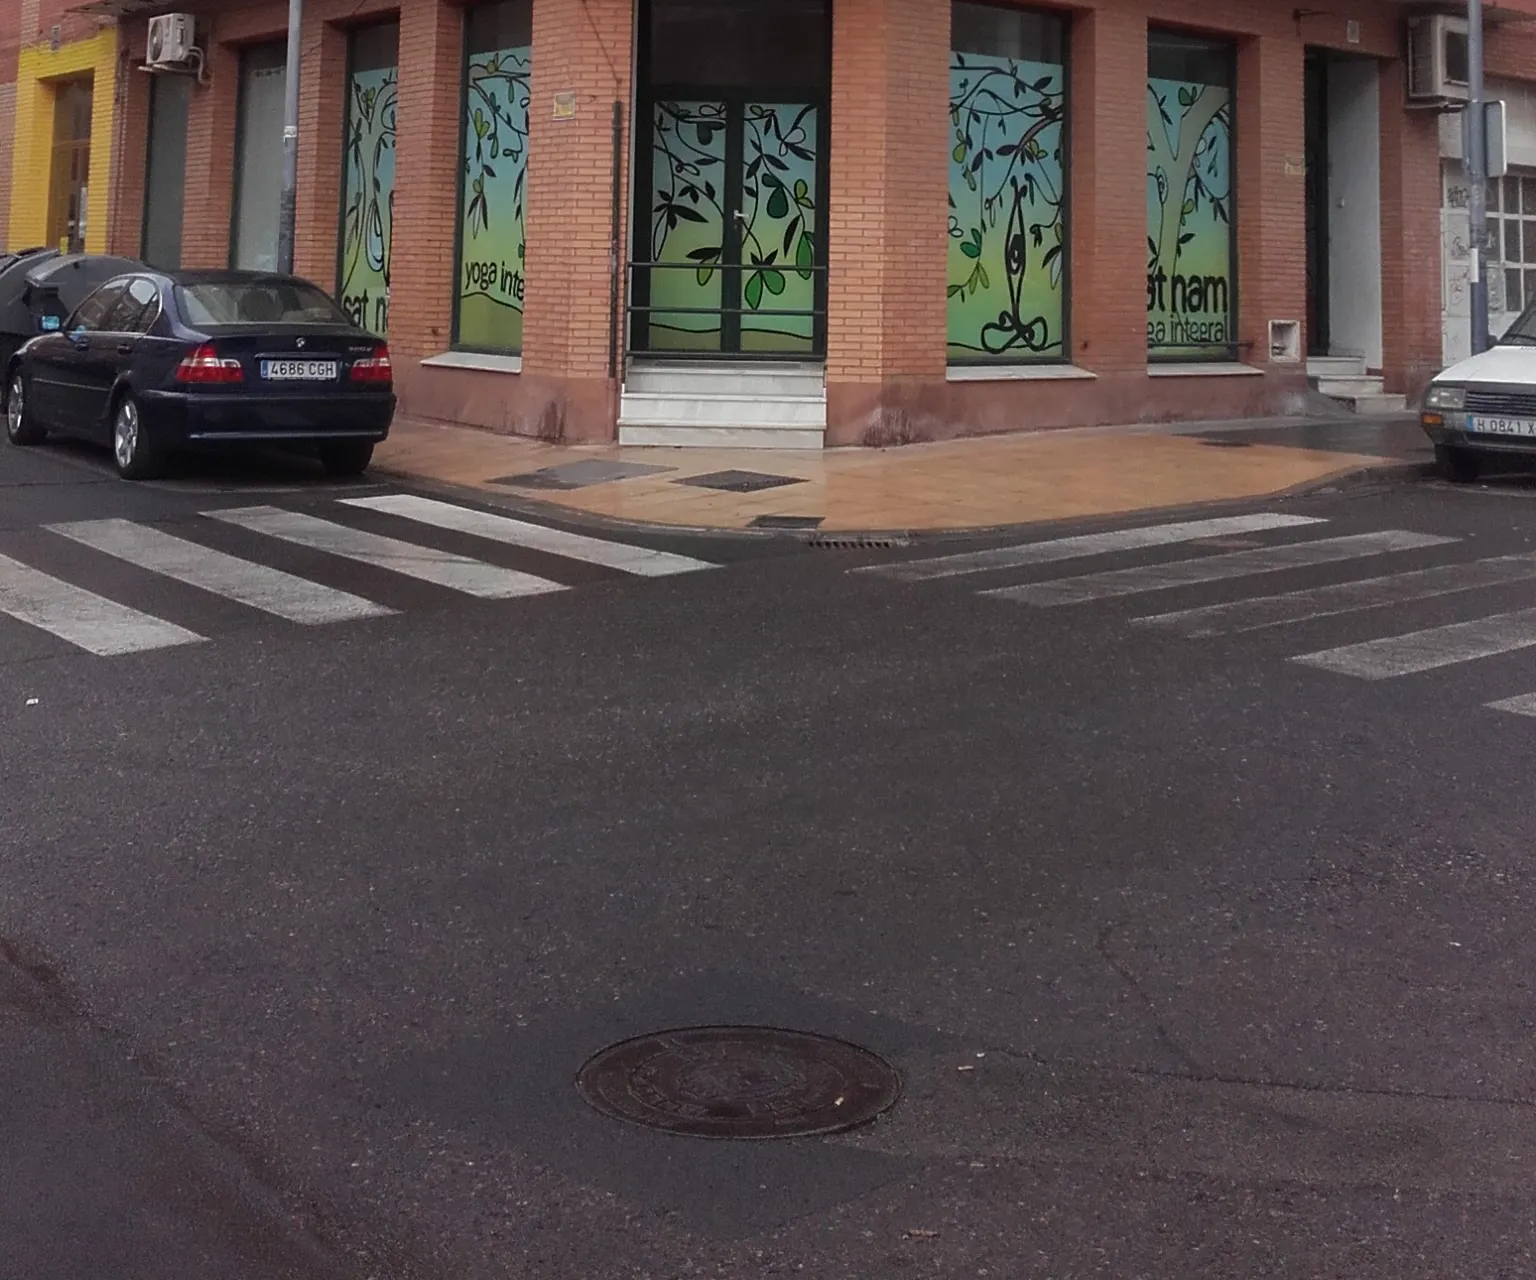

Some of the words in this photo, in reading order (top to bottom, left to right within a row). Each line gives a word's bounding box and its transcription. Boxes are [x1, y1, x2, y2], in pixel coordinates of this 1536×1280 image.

[465, 261, 498, 291] yoga
[1171, 274, 1228, 314] nam
[375, 297, 390, 333] n
[1170, 314, 1228, 344] integral
[271, 362, 305, 376] 4686
[308, 362, 334, 376] CGH
[1477, 419, 1485, 431] H
